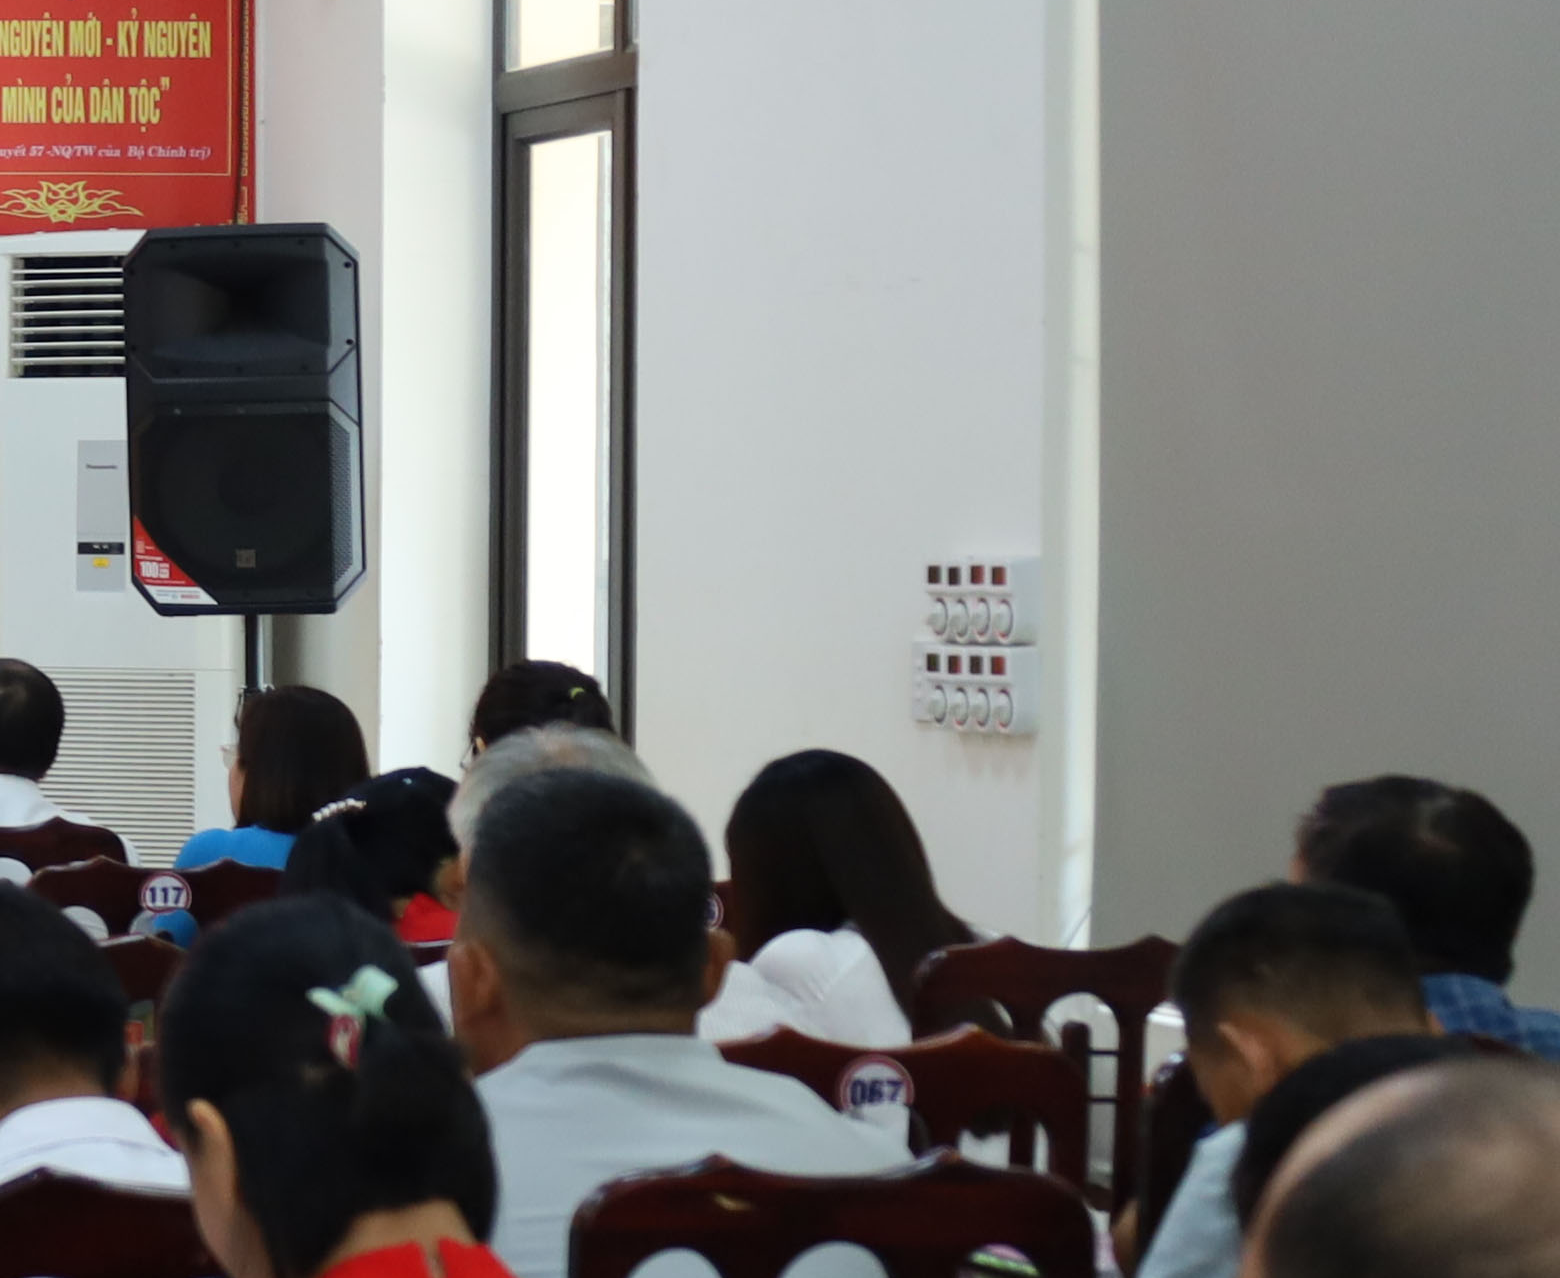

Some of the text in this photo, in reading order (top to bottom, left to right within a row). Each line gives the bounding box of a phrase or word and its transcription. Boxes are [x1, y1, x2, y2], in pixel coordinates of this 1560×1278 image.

[2, 78, 47, 123] MÌNH
[51, 74, 85, 123] CỦA
[90, 79, 124, 123] DÂN
[129, 77, 169, 132] TỘC”
[149, 886, 185, 906] 117
